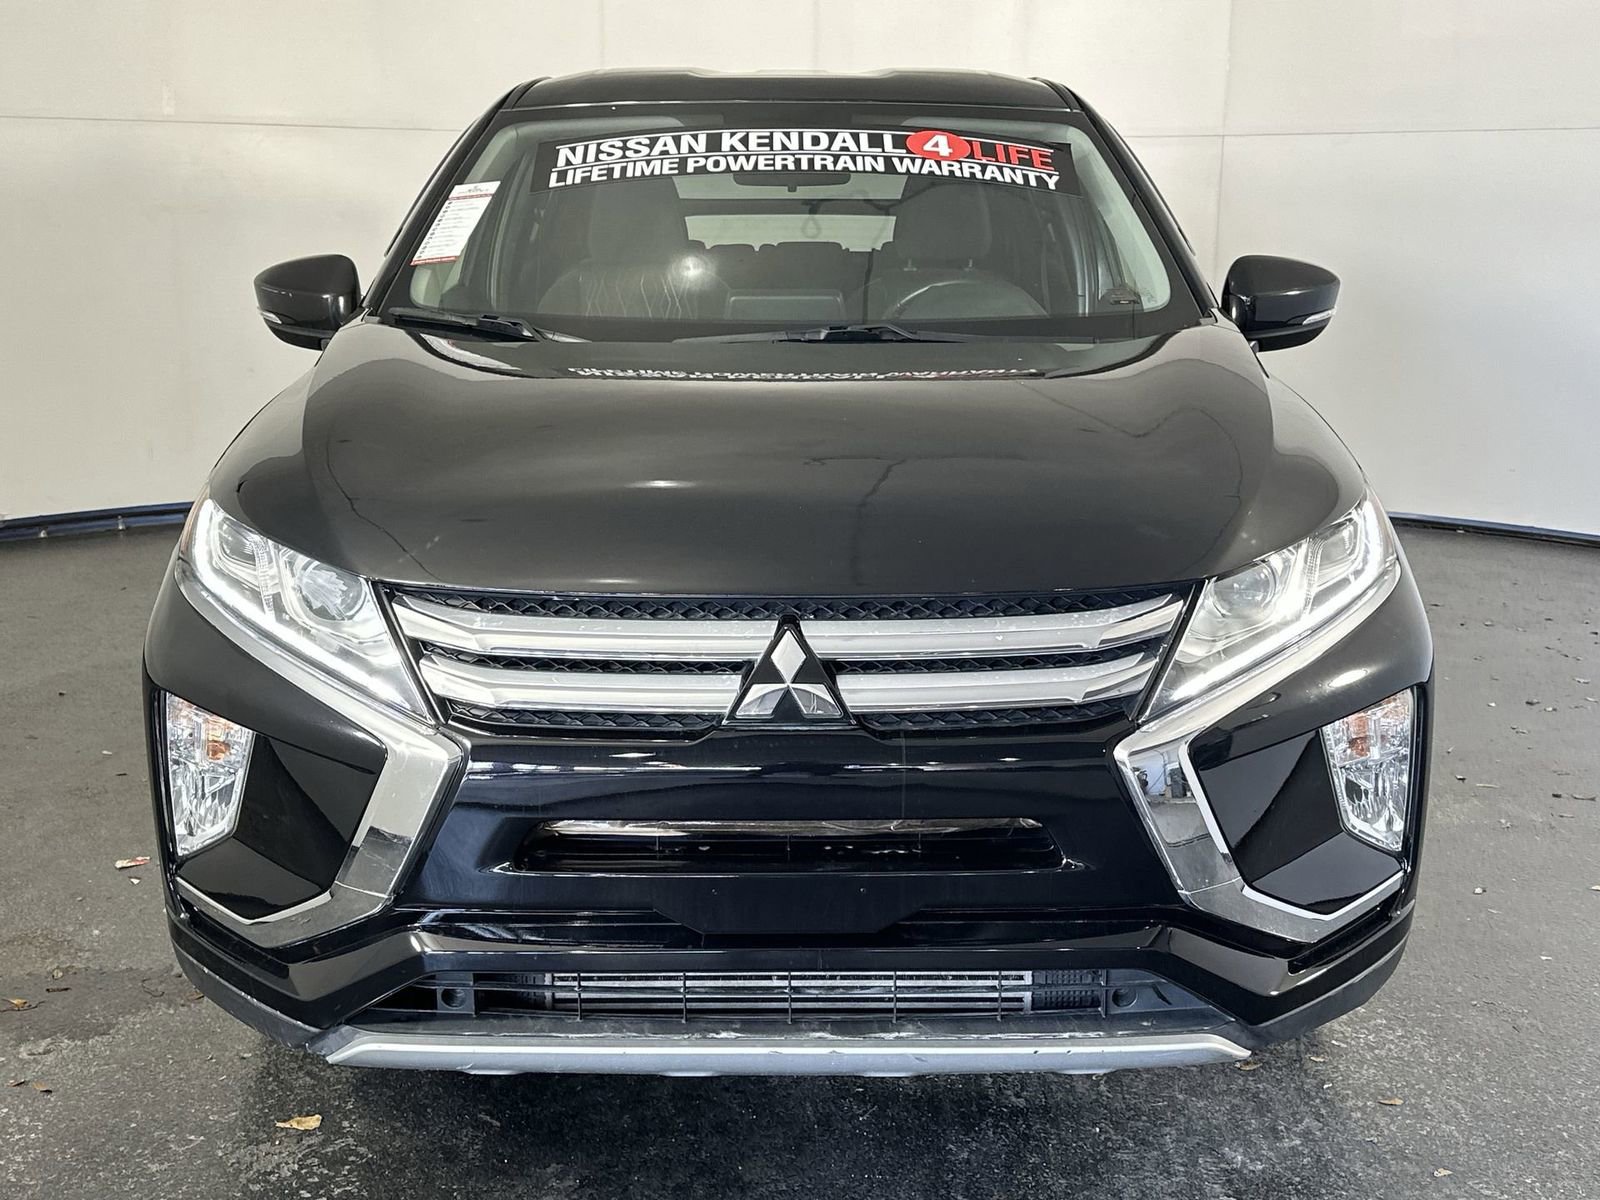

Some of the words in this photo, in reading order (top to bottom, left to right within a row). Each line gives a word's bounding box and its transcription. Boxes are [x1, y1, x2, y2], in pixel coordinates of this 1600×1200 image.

[556, 133, 706, 168] NISSAN
[721, 131, 907, 152] KENDALL
[922, 135, 953, 156] 4
[972, 141, 1055, 170] LIFE
[549, 158, 679, 188] LIFETIME
[686, 154, 885, 173] POWERTRAIN
[892, 158, 1060, 190] WARRANTY
